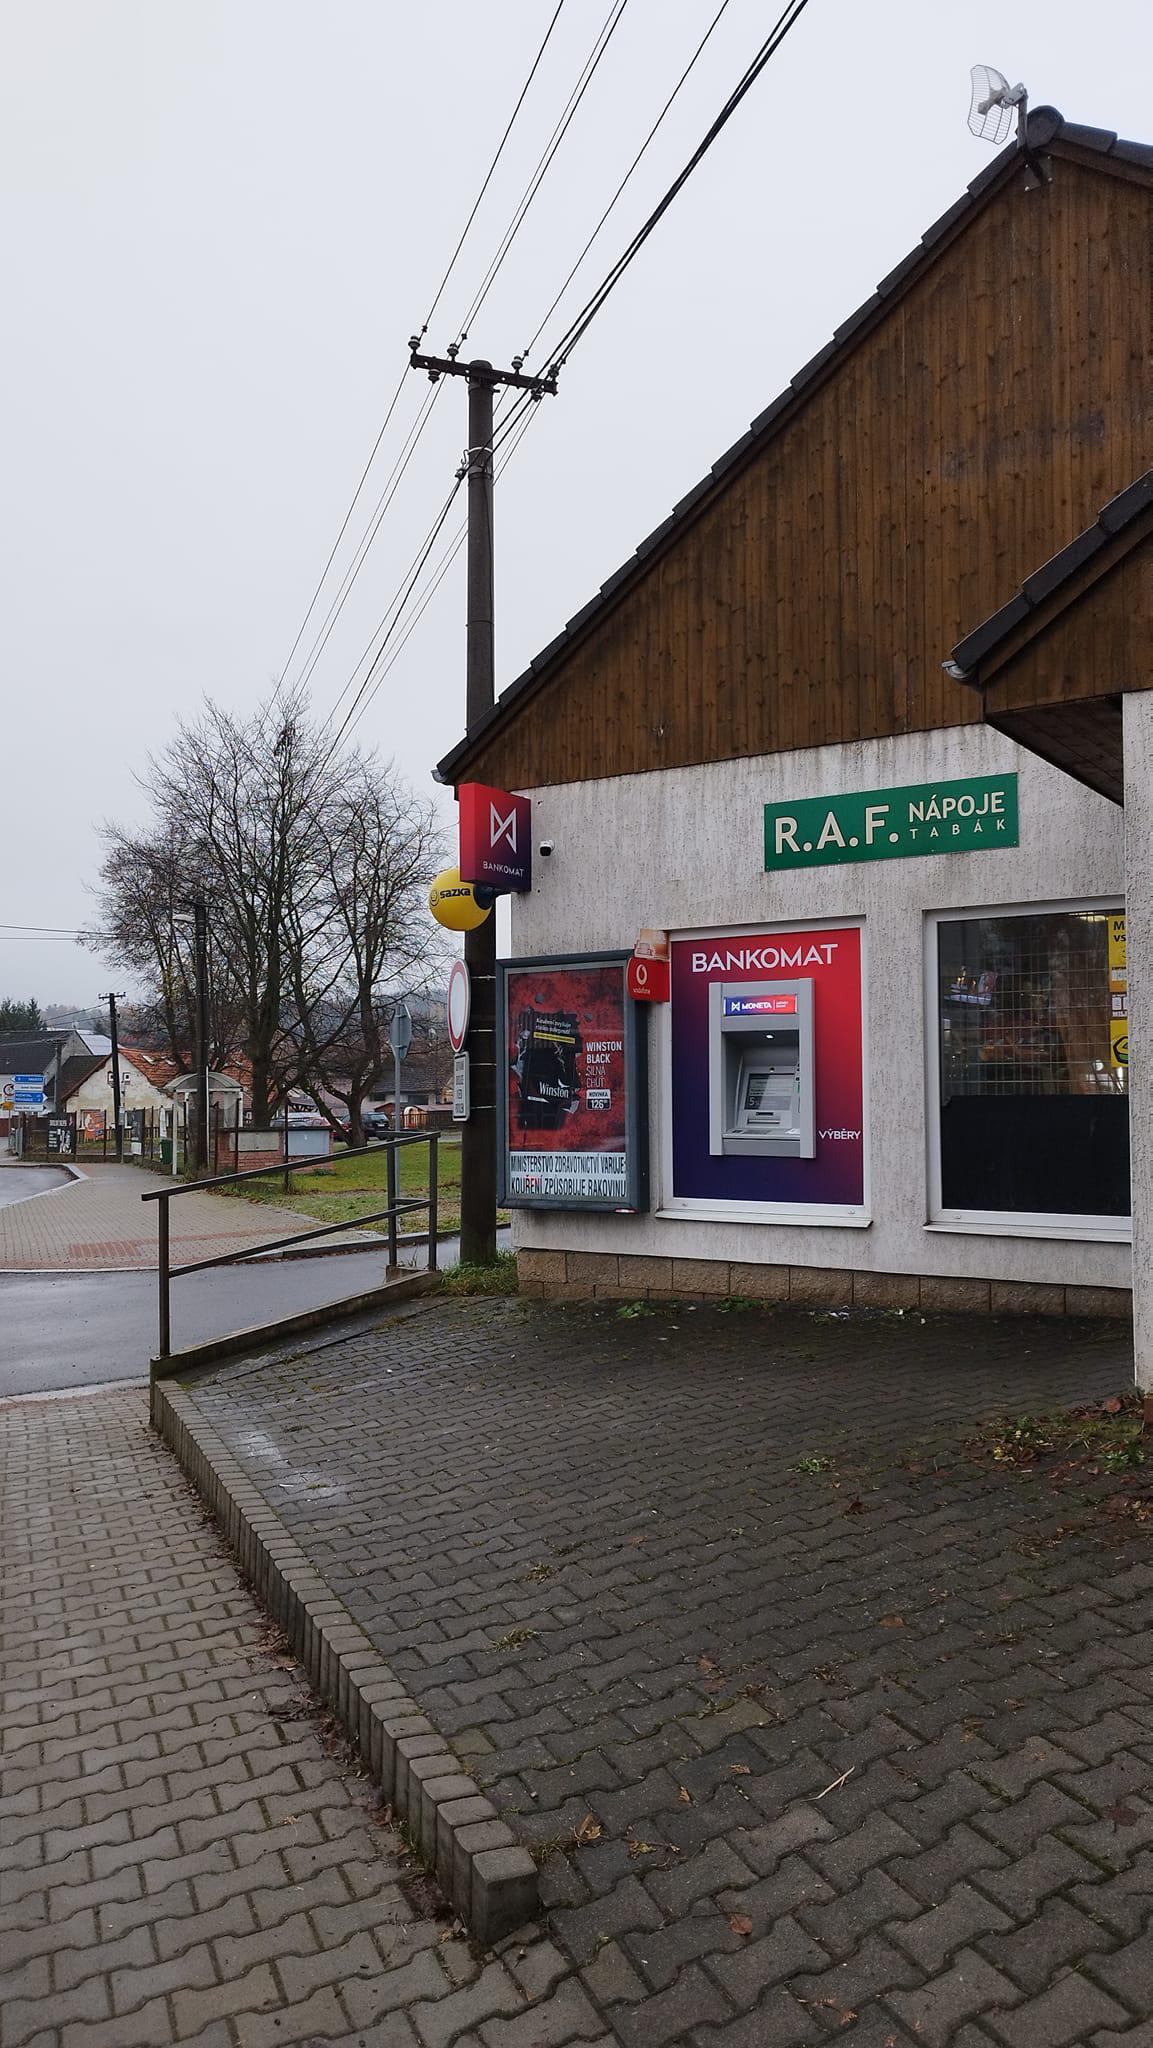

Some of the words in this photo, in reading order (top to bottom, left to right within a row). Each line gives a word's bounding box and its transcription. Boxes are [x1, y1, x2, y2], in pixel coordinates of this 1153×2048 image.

[774, 805, 899, 854] R.A.F.
[908, 791, 1006, 823] NÁPOJE
[909, 818, 1006, 840] TABÁK
[482, 860, 525, 878] BANKOMAT
[691, 943, 839, 973] BANKOMAT
[741, 1001, 772, 1010] MONETA
[586, 1040, 622, 1051] WINSTON
[586, 1053, 611, 1064] BLACK
[539, 1080, 569, 1099] Winston
[818, 1127, 862, 1140] VÝBĚRY
[511, 1155, 554, 1173] MINISTERSTVO
[555, 1153, 600, 1174] ZDRAVOTNICTVÍ
[600, 1156, 625, 1174] VARUJE
[511, 1174, 544, 1194] KOUŘENÍ
[544, 1175, 586, 1197] ZPŮSOBUJE
[588, 1179, 626, 1198] RAKOVINU
